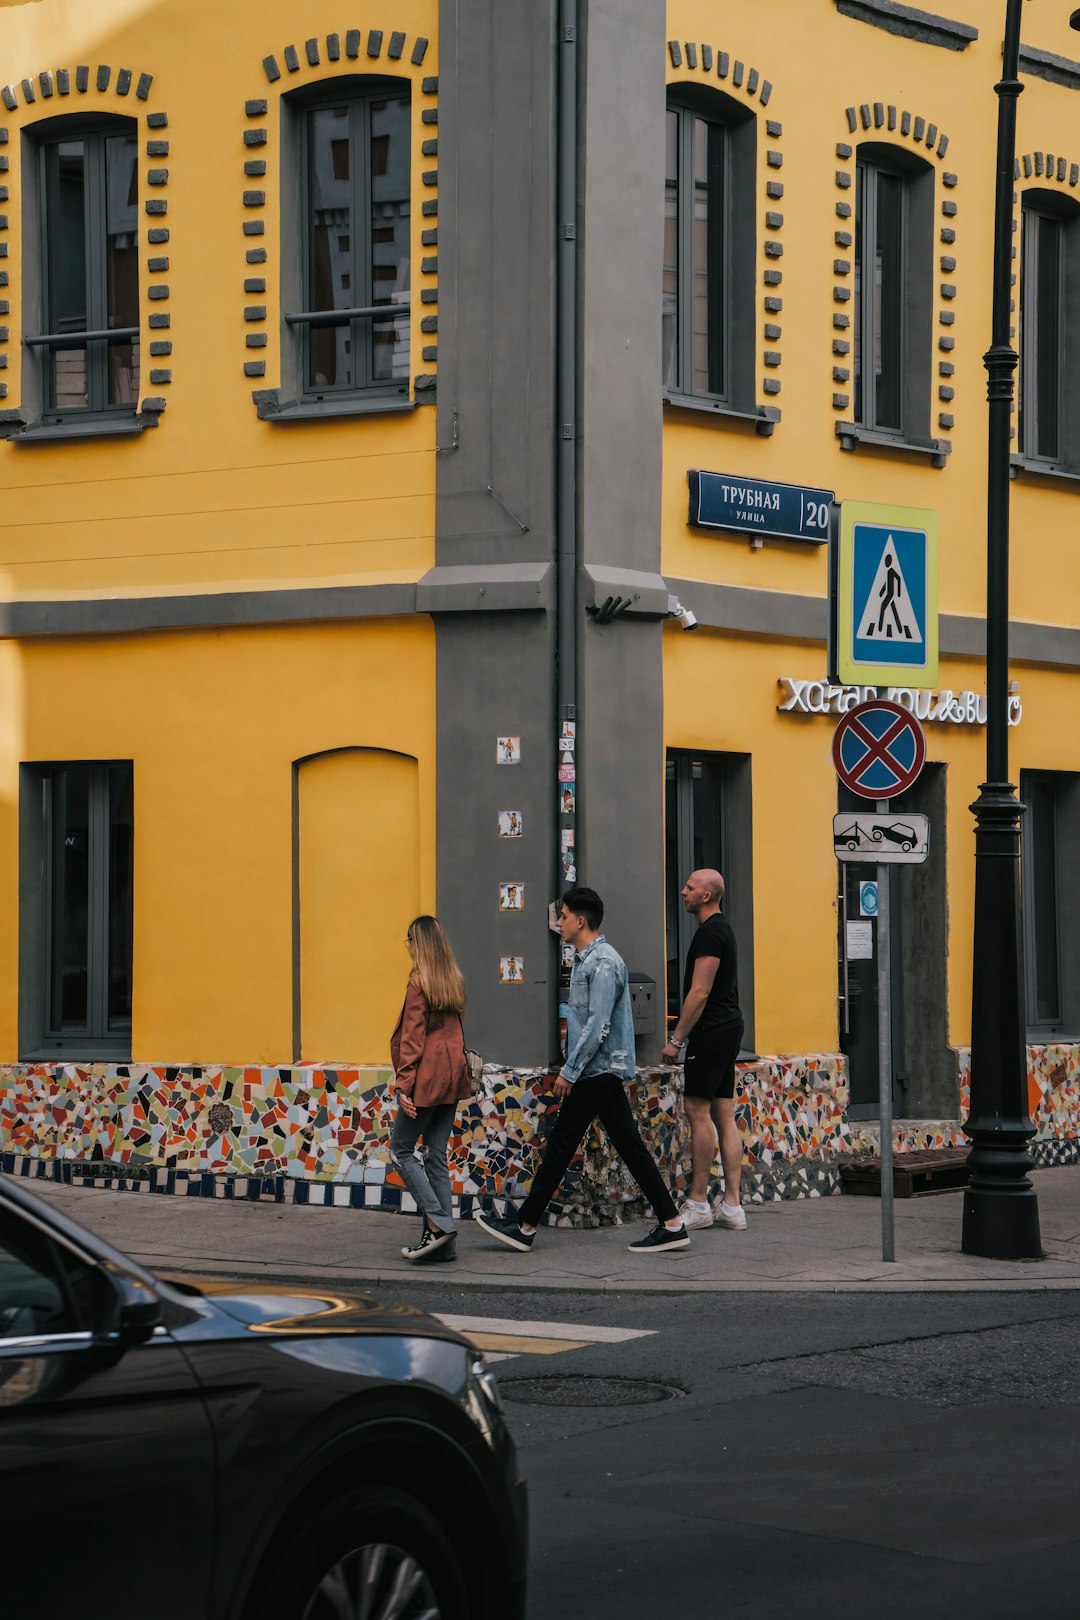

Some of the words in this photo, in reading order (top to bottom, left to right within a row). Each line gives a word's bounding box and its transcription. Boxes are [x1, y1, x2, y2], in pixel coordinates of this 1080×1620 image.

[721, 485, 780, 511] ТРУБНАЯ
[736, 510, 765, 523] УЛИЦА
[806, 502, 828, 529] 20
